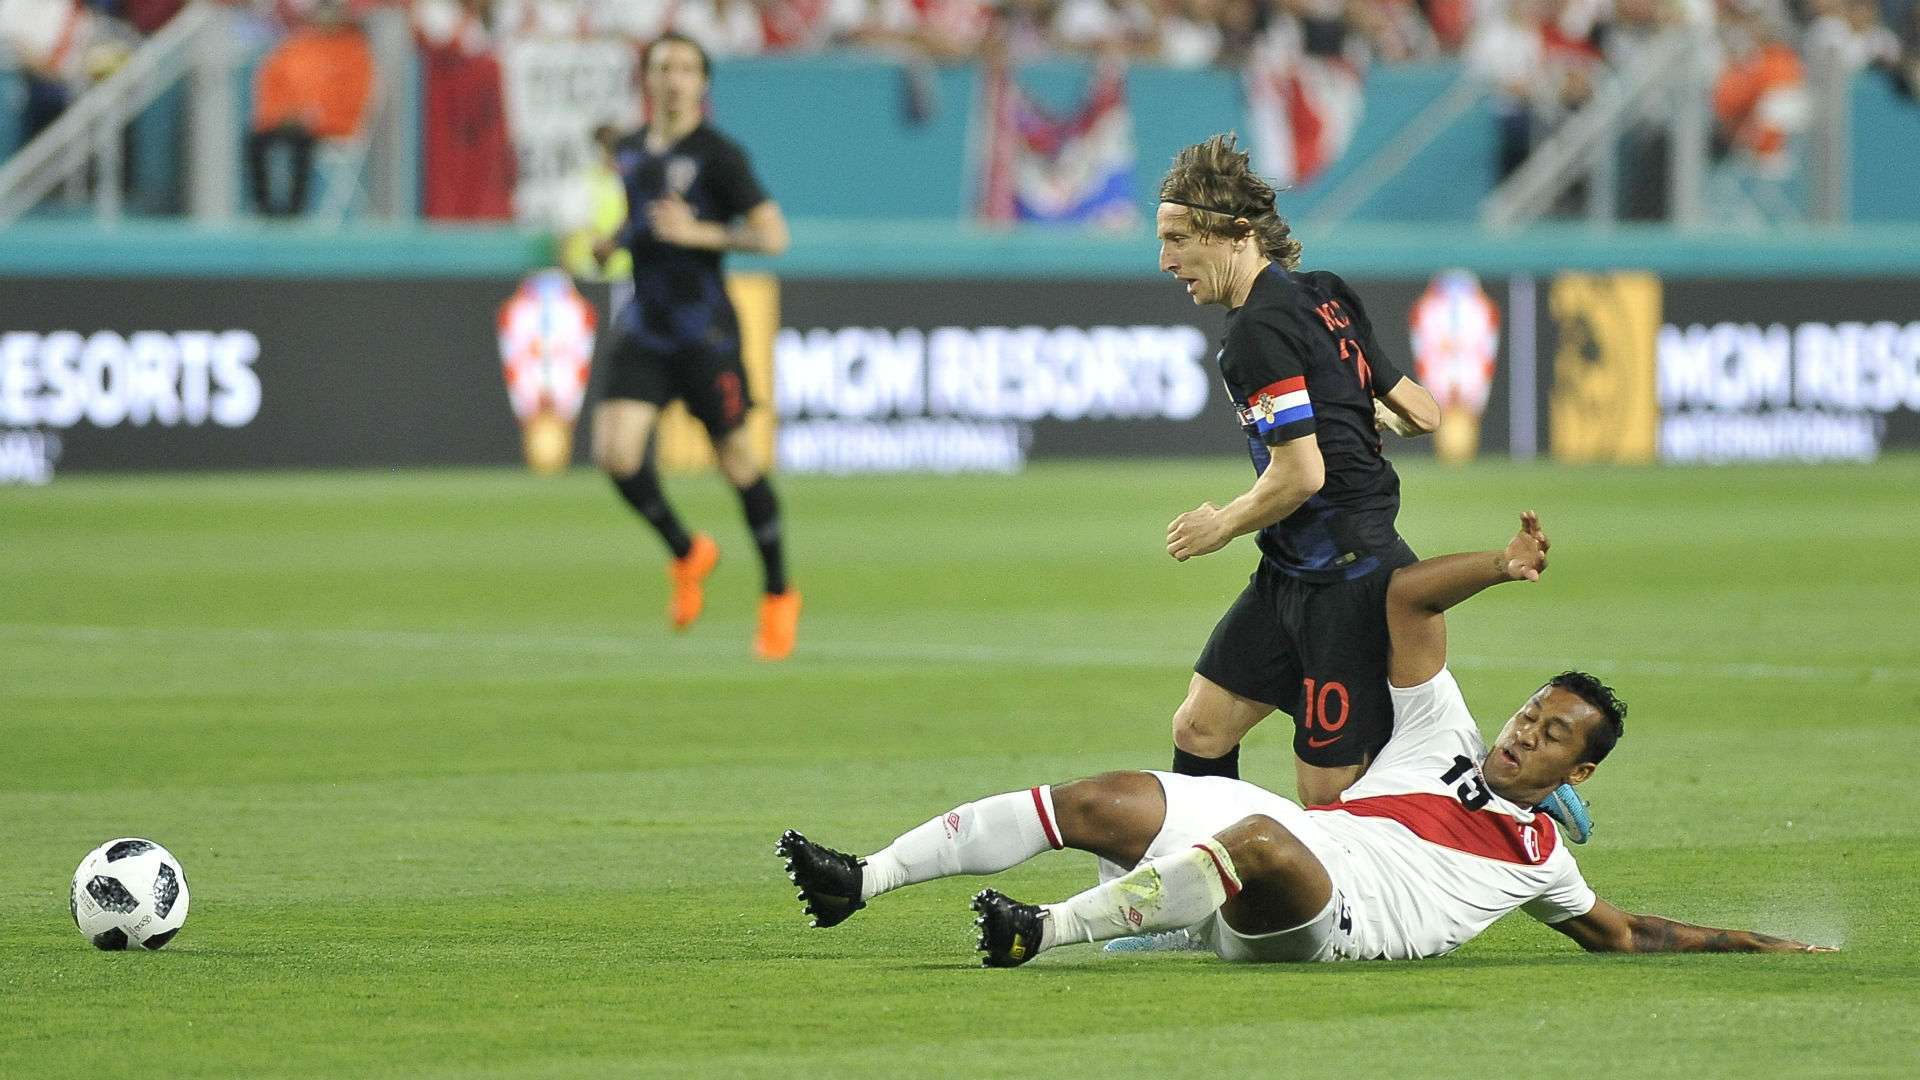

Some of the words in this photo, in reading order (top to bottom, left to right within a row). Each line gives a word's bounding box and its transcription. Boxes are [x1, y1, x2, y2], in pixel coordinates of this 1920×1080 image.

[776, 328, 926, 416] MGM
[927, 326, 1208, 419] RESORTS
[1657, 322, 1791, 408] MGM
[1303, 677, 1349, 732] 10
